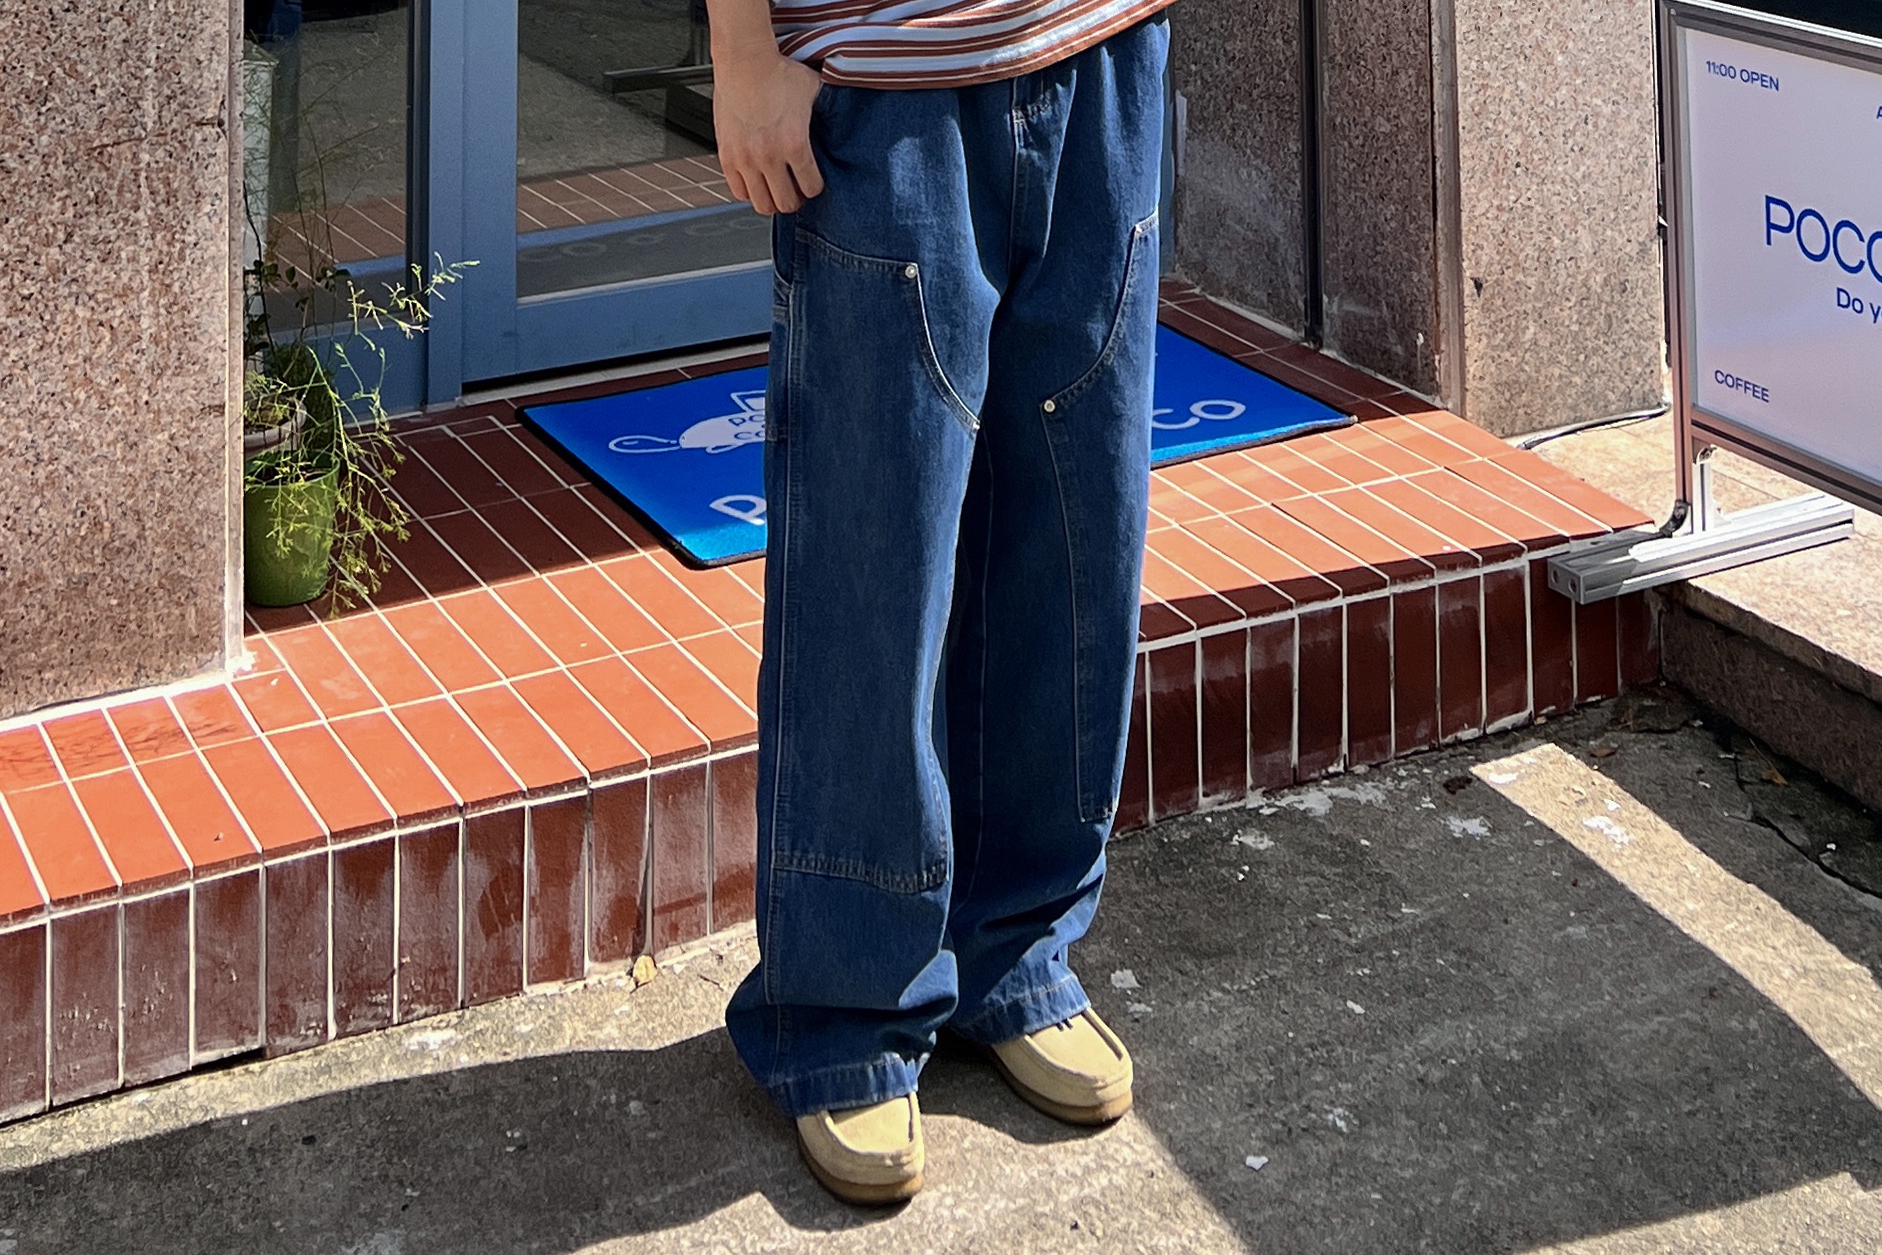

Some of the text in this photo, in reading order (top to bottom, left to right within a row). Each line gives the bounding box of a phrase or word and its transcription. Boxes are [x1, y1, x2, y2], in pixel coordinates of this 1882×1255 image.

[1706, 60, 1780, 92] 11:00 OPEN
[1836, 286, 1864, 315] Do
[1714, 369, 1770, 404] COFFEE
